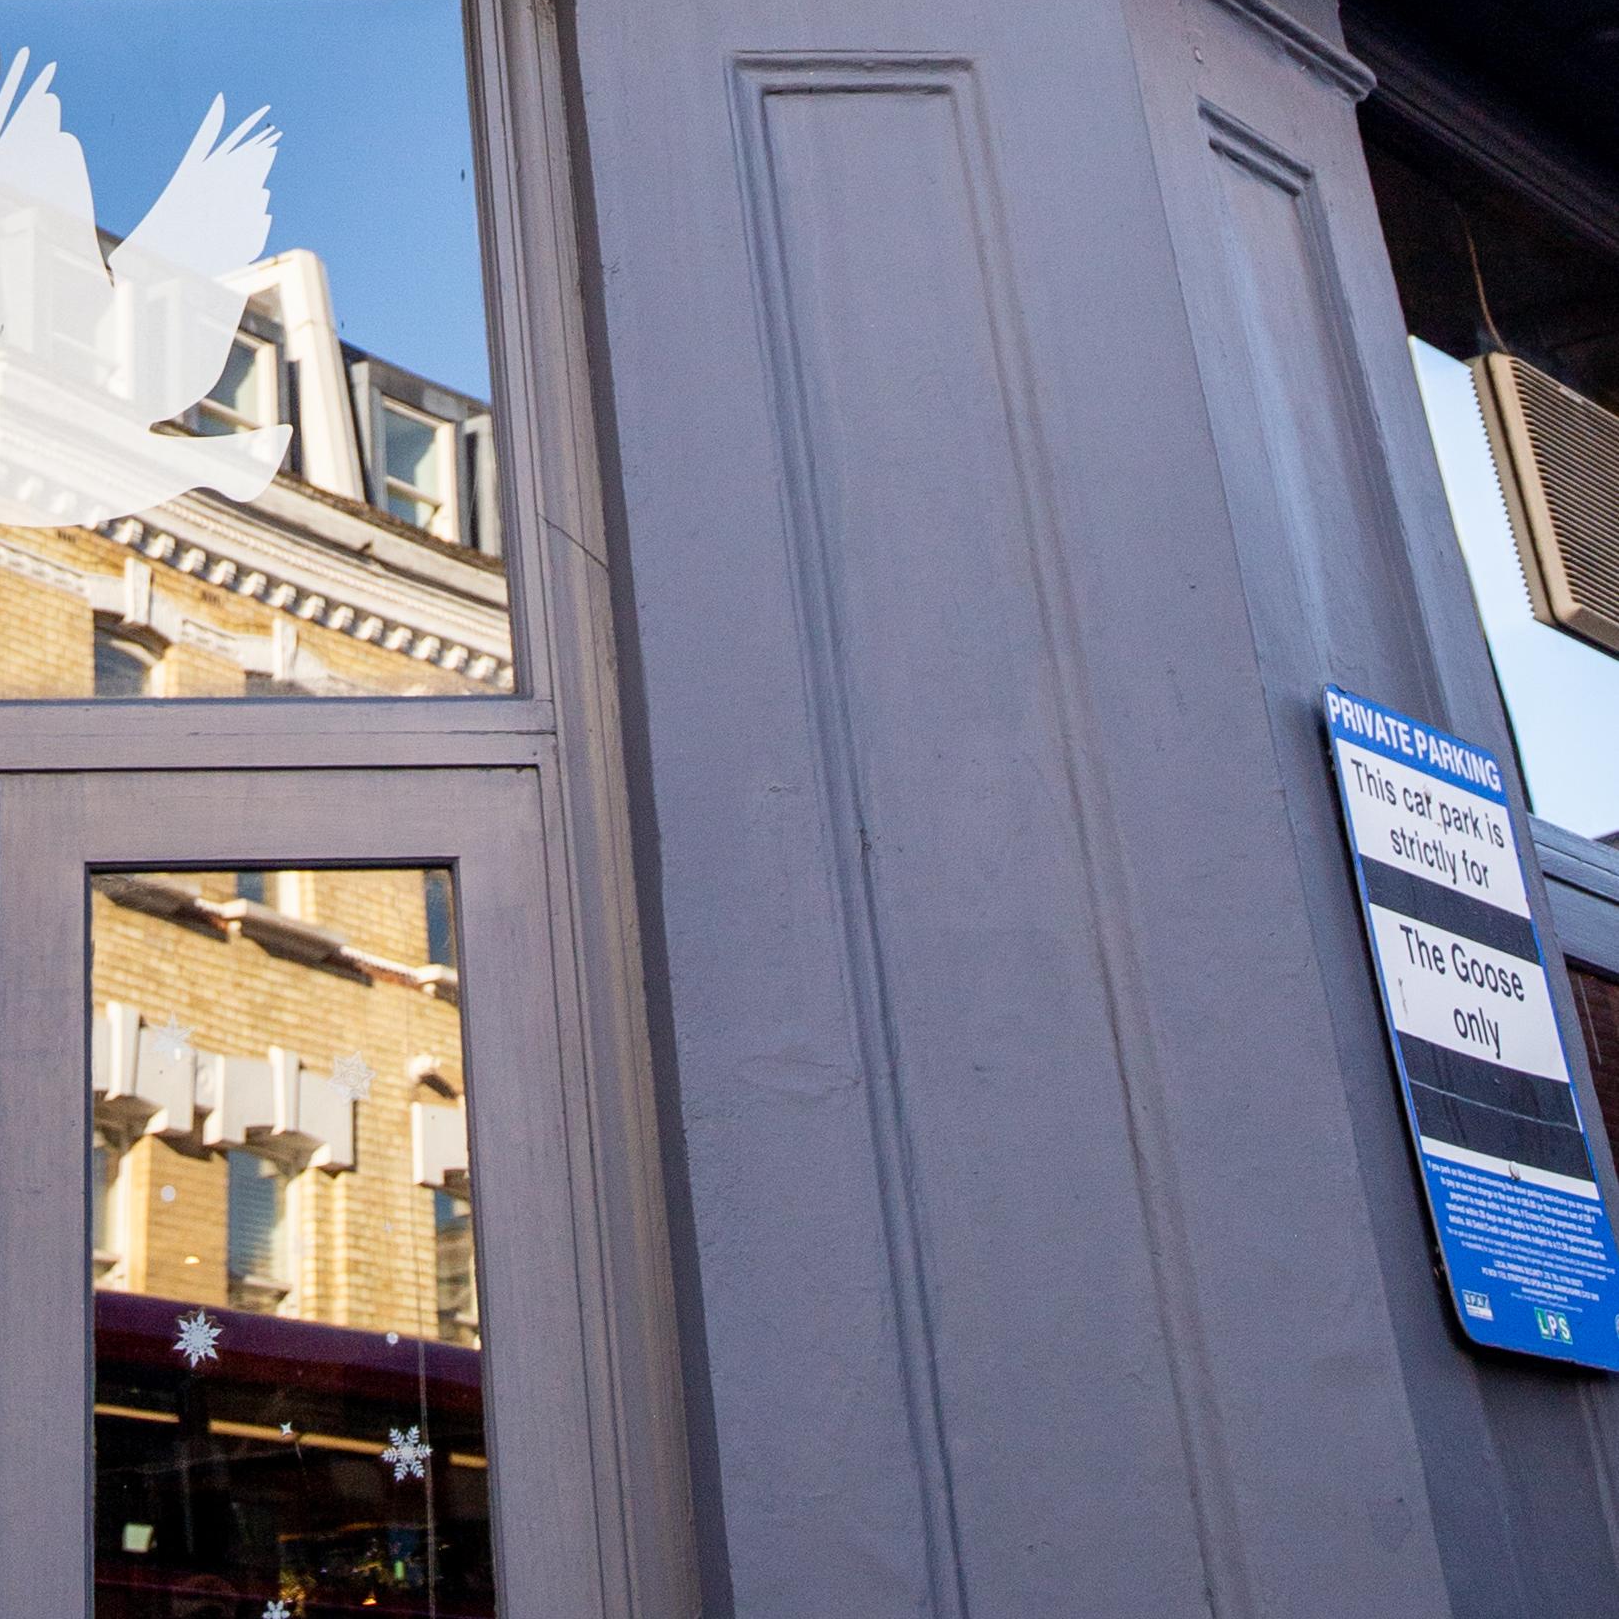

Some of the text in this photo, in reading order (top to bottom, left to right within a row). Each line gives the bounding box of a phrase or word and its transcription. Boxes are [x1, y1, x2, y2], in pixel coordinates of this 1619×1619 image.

[1326, 690, 1503, 793] PRIVATE PARKING
[1350, 758, 1505, 849] This car park is
[1390, 827, 1489, 889] strictly for
[1399, 923, 1526, 1002] The Goose
[1453, 1007, 1502, 1060] only
[1537, 1311, 1571, 1340] LPS
